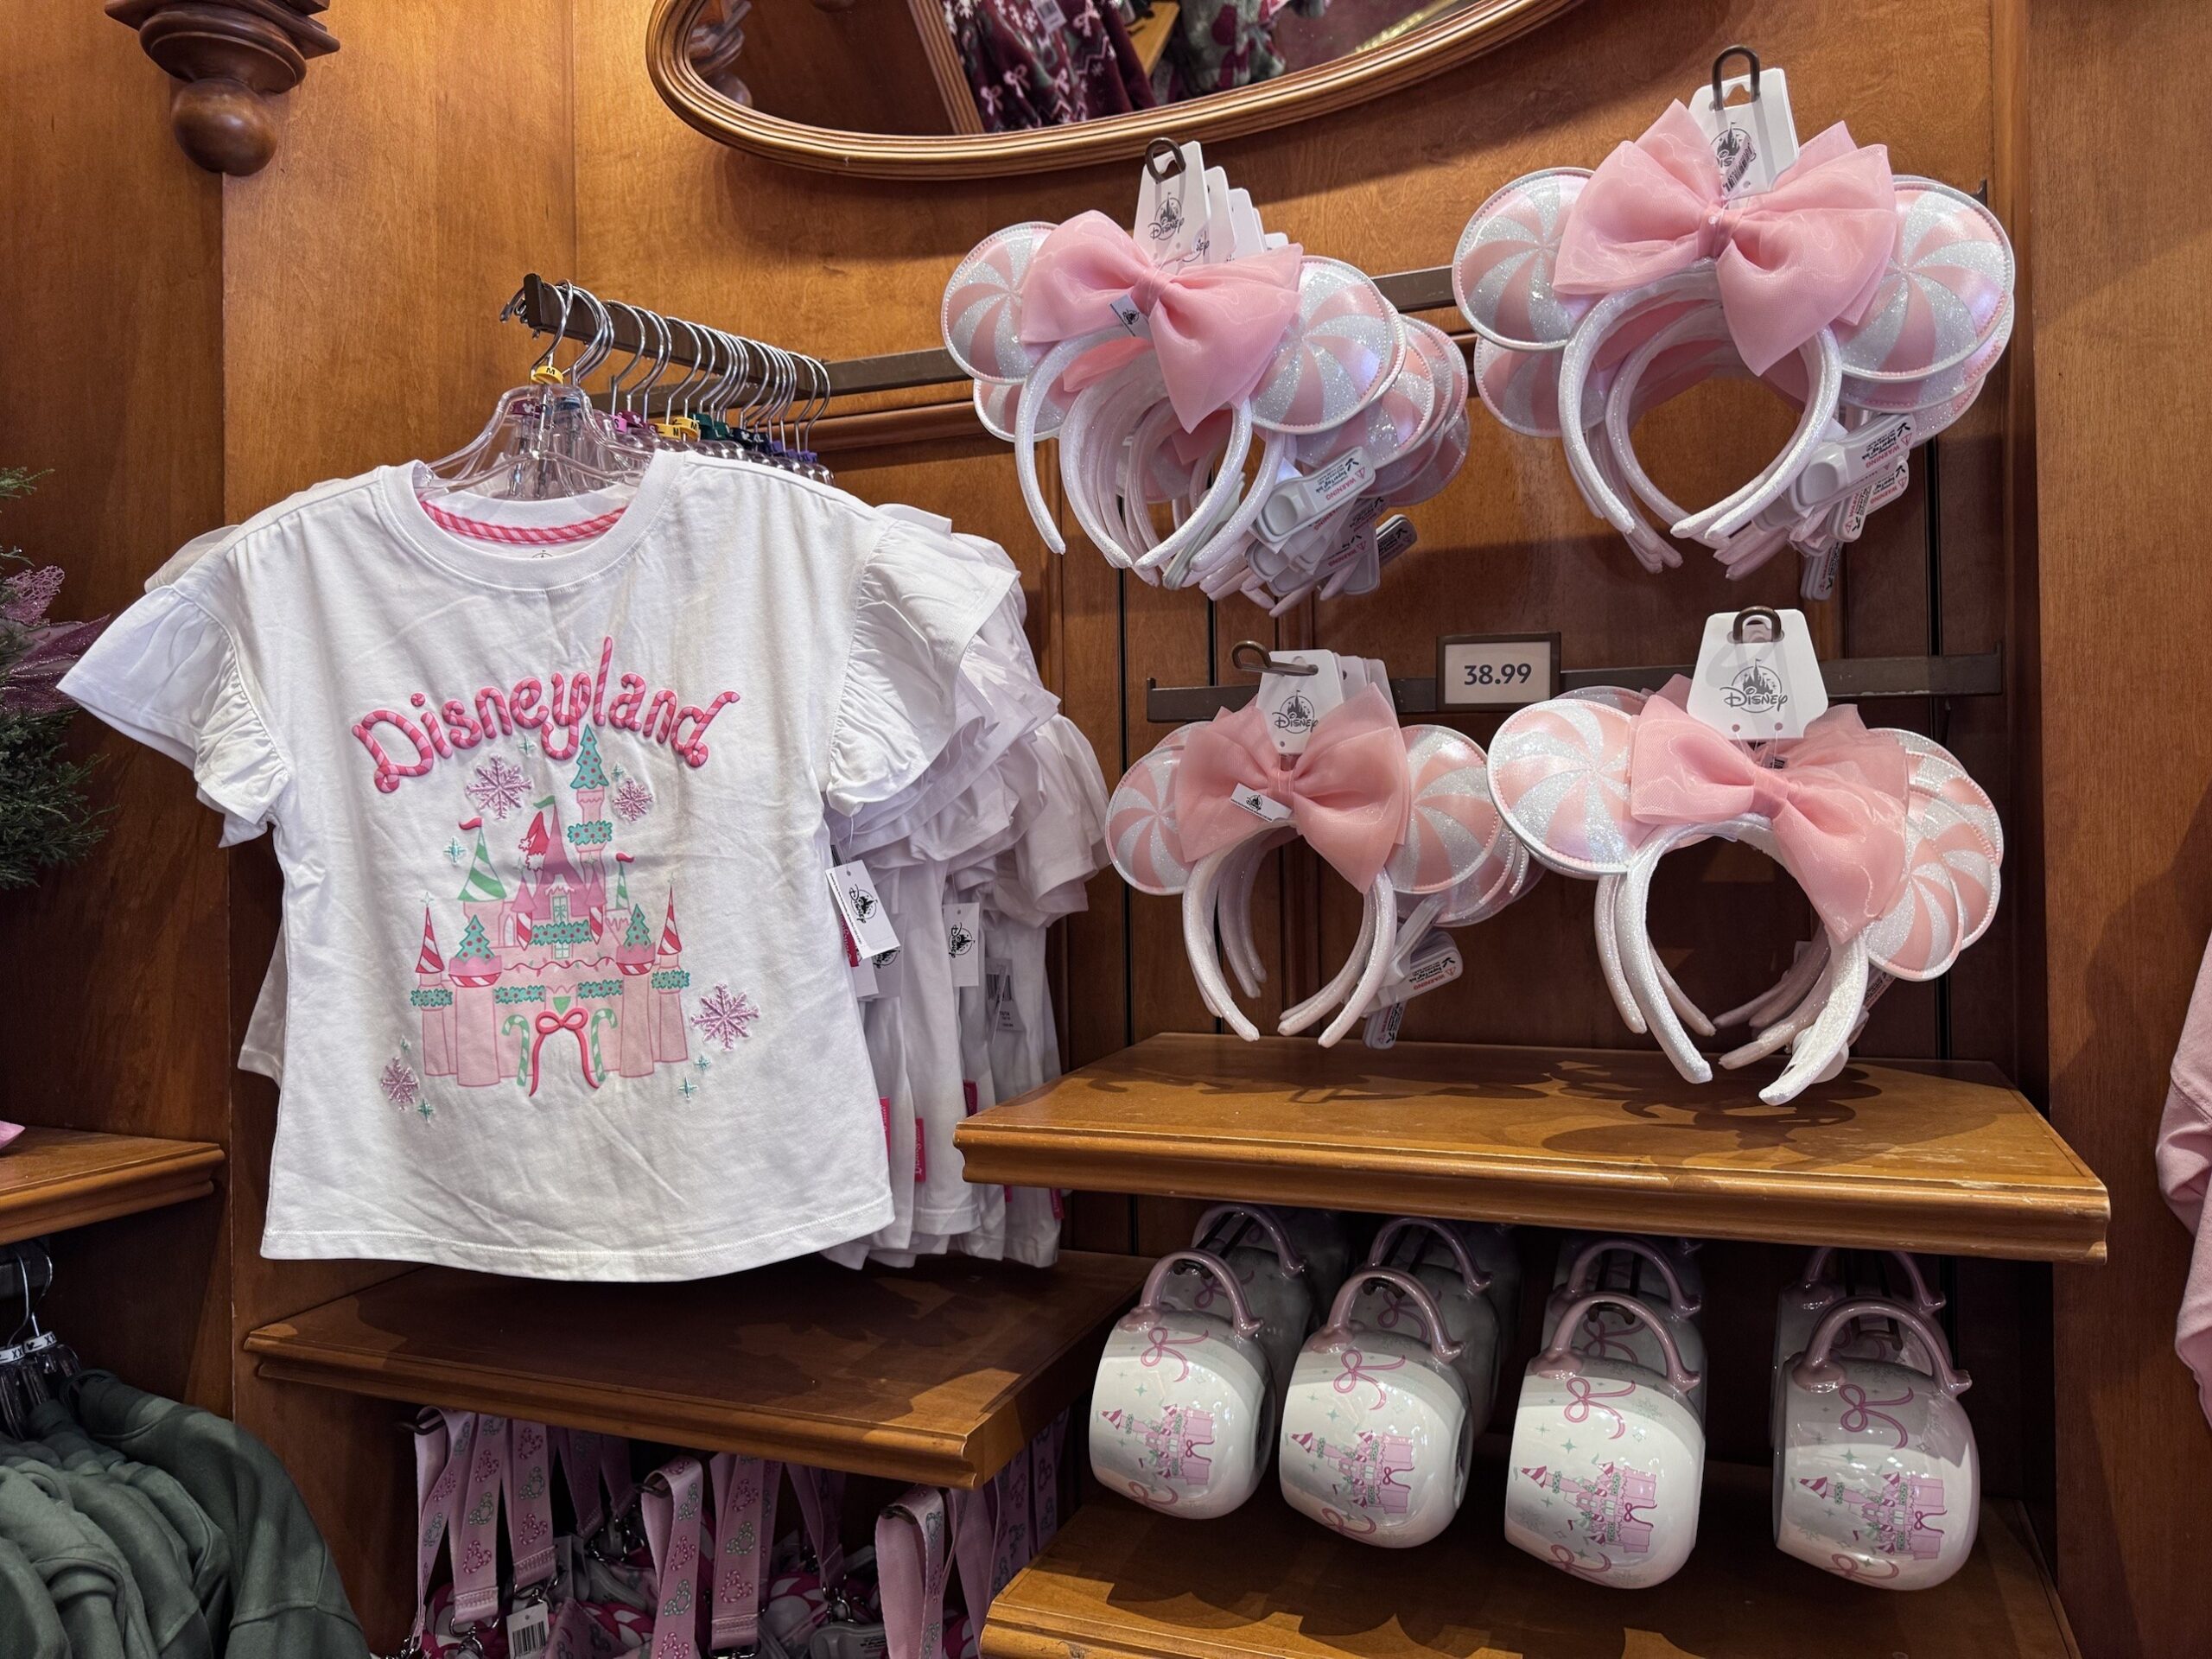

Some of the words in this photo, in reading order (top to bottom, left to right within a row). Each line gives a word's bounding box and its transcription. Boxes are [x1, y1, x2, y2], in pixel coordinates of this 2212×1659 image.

[613, 418, 620, 429] S
[691, 421, 697, 430] M
[1865, 444, 1899, 468] WARNING
[1325, 477, 1356, 500] WARNING
[1464, 663, 1532, 685] 38.99
[1719, 686, 1788, 712] Disney
[352, 636, 741, 793] Disneyland
[1272, 712, 1319, 733] Disney
